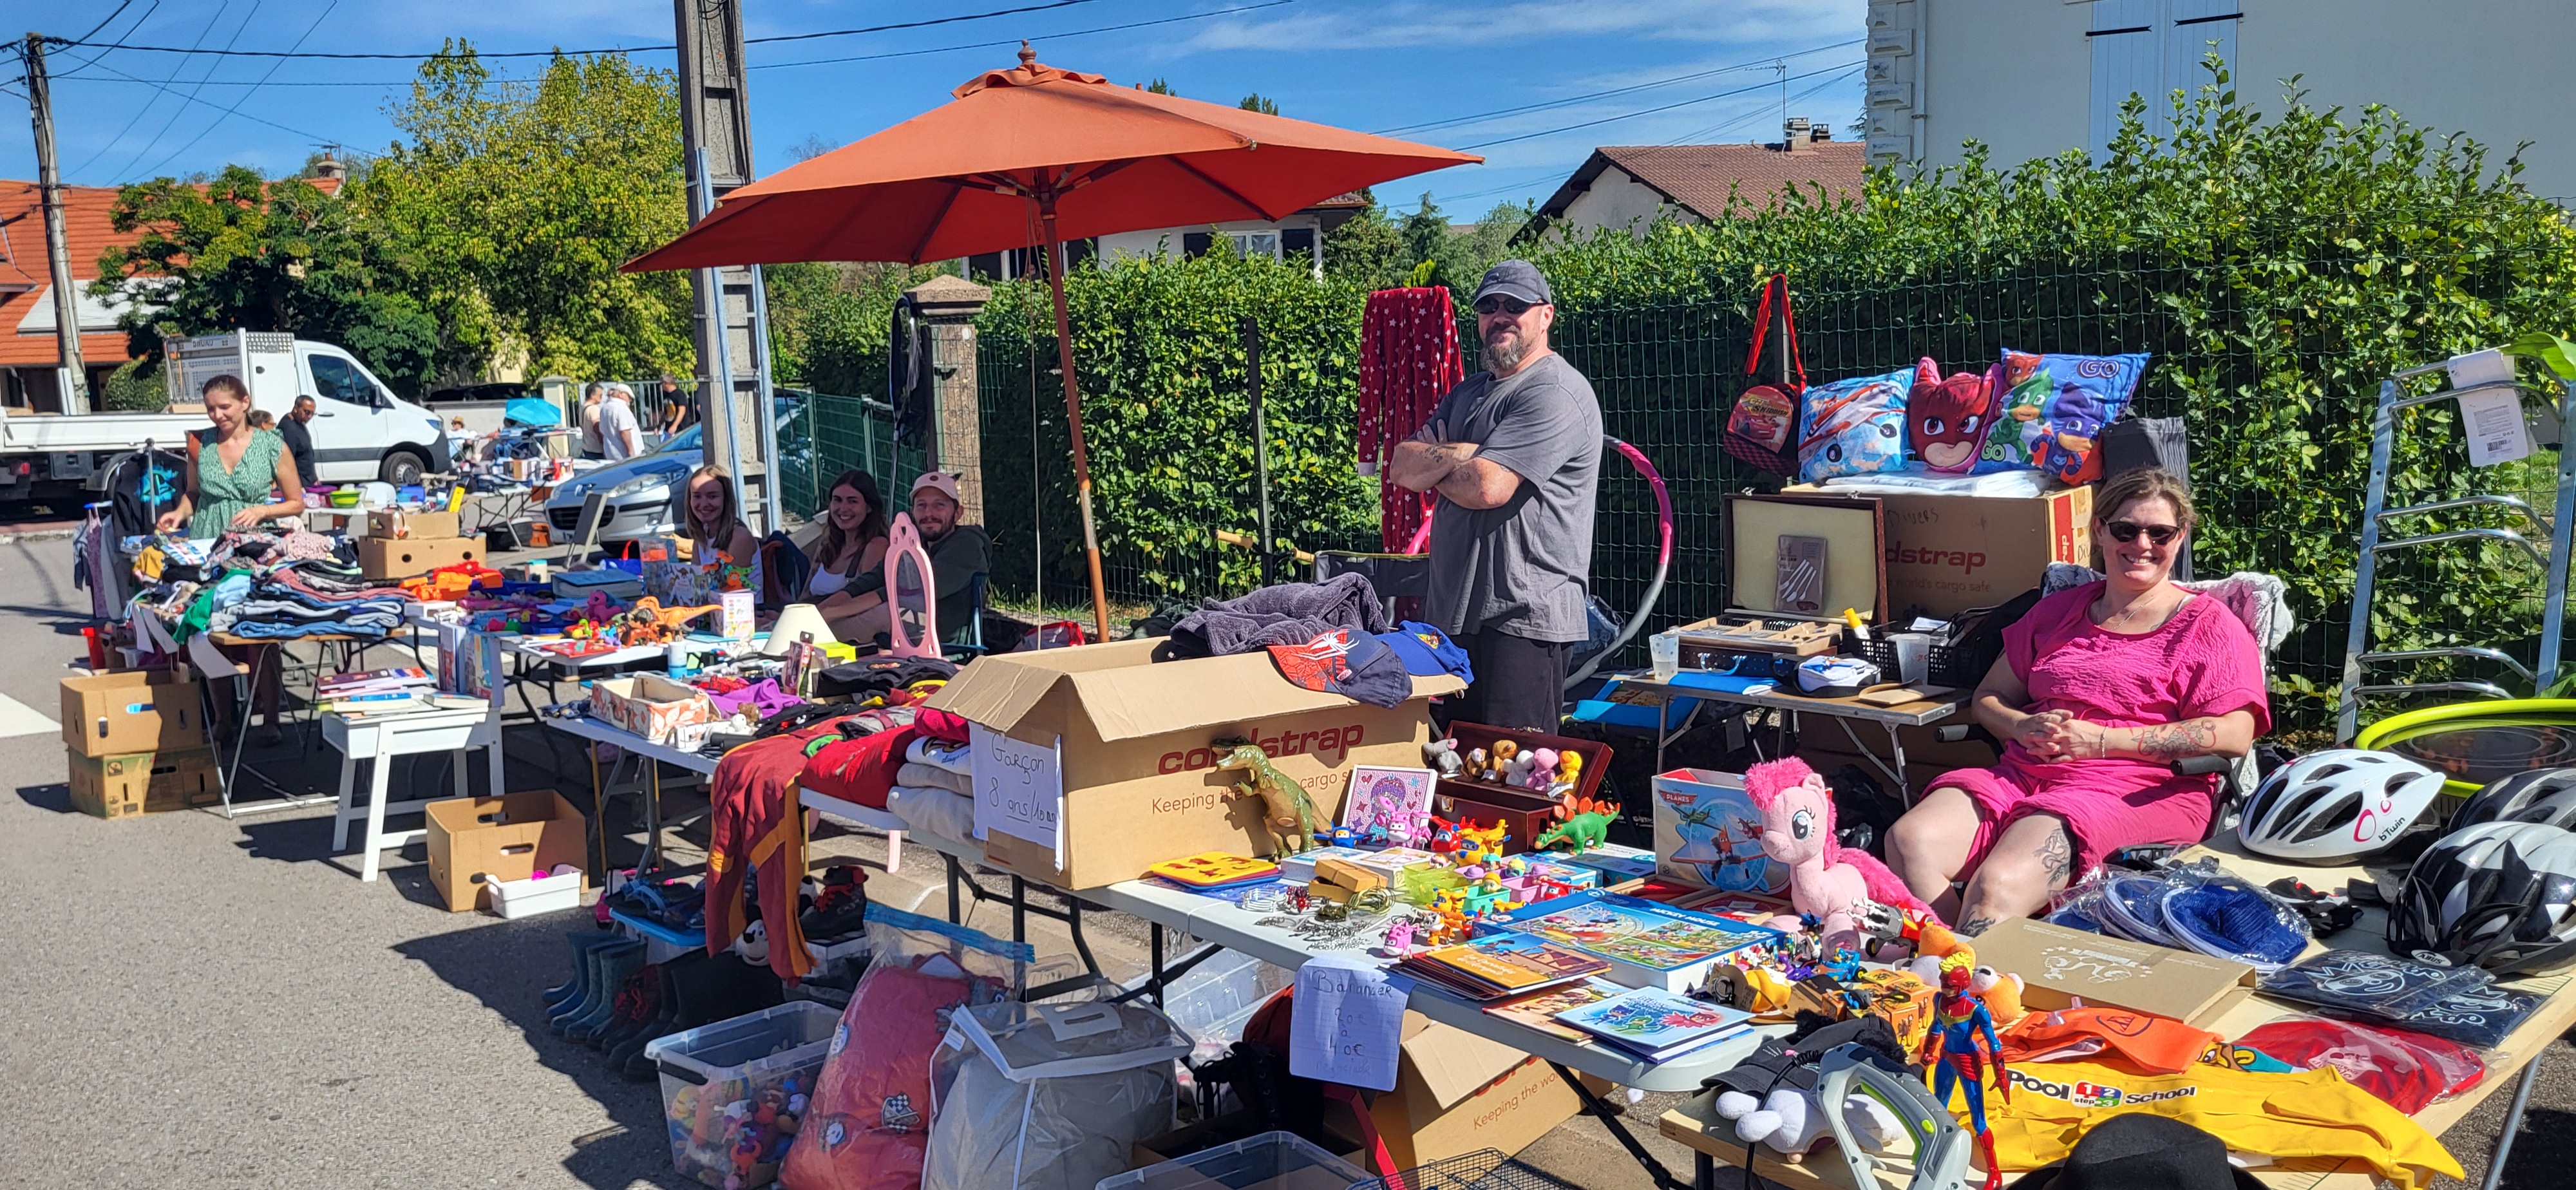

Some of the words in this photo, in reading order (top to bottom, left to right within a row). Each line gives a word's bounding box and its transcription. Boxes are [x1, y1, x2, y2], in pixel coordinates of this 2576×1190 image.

[2076, 359, 2121, 379] GO
[1980, 439, 2007, 462] GO
[1886, 540, 1986, 575] dstrap
[1935, 581, 1966, 593] cargo
[1969, 581, 1992, 592] safe
[1159, 724, 1364, 775] costrap
[989, 777, 999, 808] 8
[1152, 792, 1215, 815] Keeping
[1220, 787, 1243, 803] the
[1300, 773, 1338, 793] cargo
[1666, 794, 1690, 803] PLANES
[1649, 907, 1685, 920] MICKEY
[1685, 915, 1721, 926] MOUSE
[2418, 953, 2443, 965] ABUS
[2006, 1070, 2070, 1100] Pool
[2125, 1086, 2195, 1104] School
[1473, 1096, 1519, 1129] Keeping
[1521, 1082, 1538, 1100] the
[2074, 1097, 2094, 1106] step
